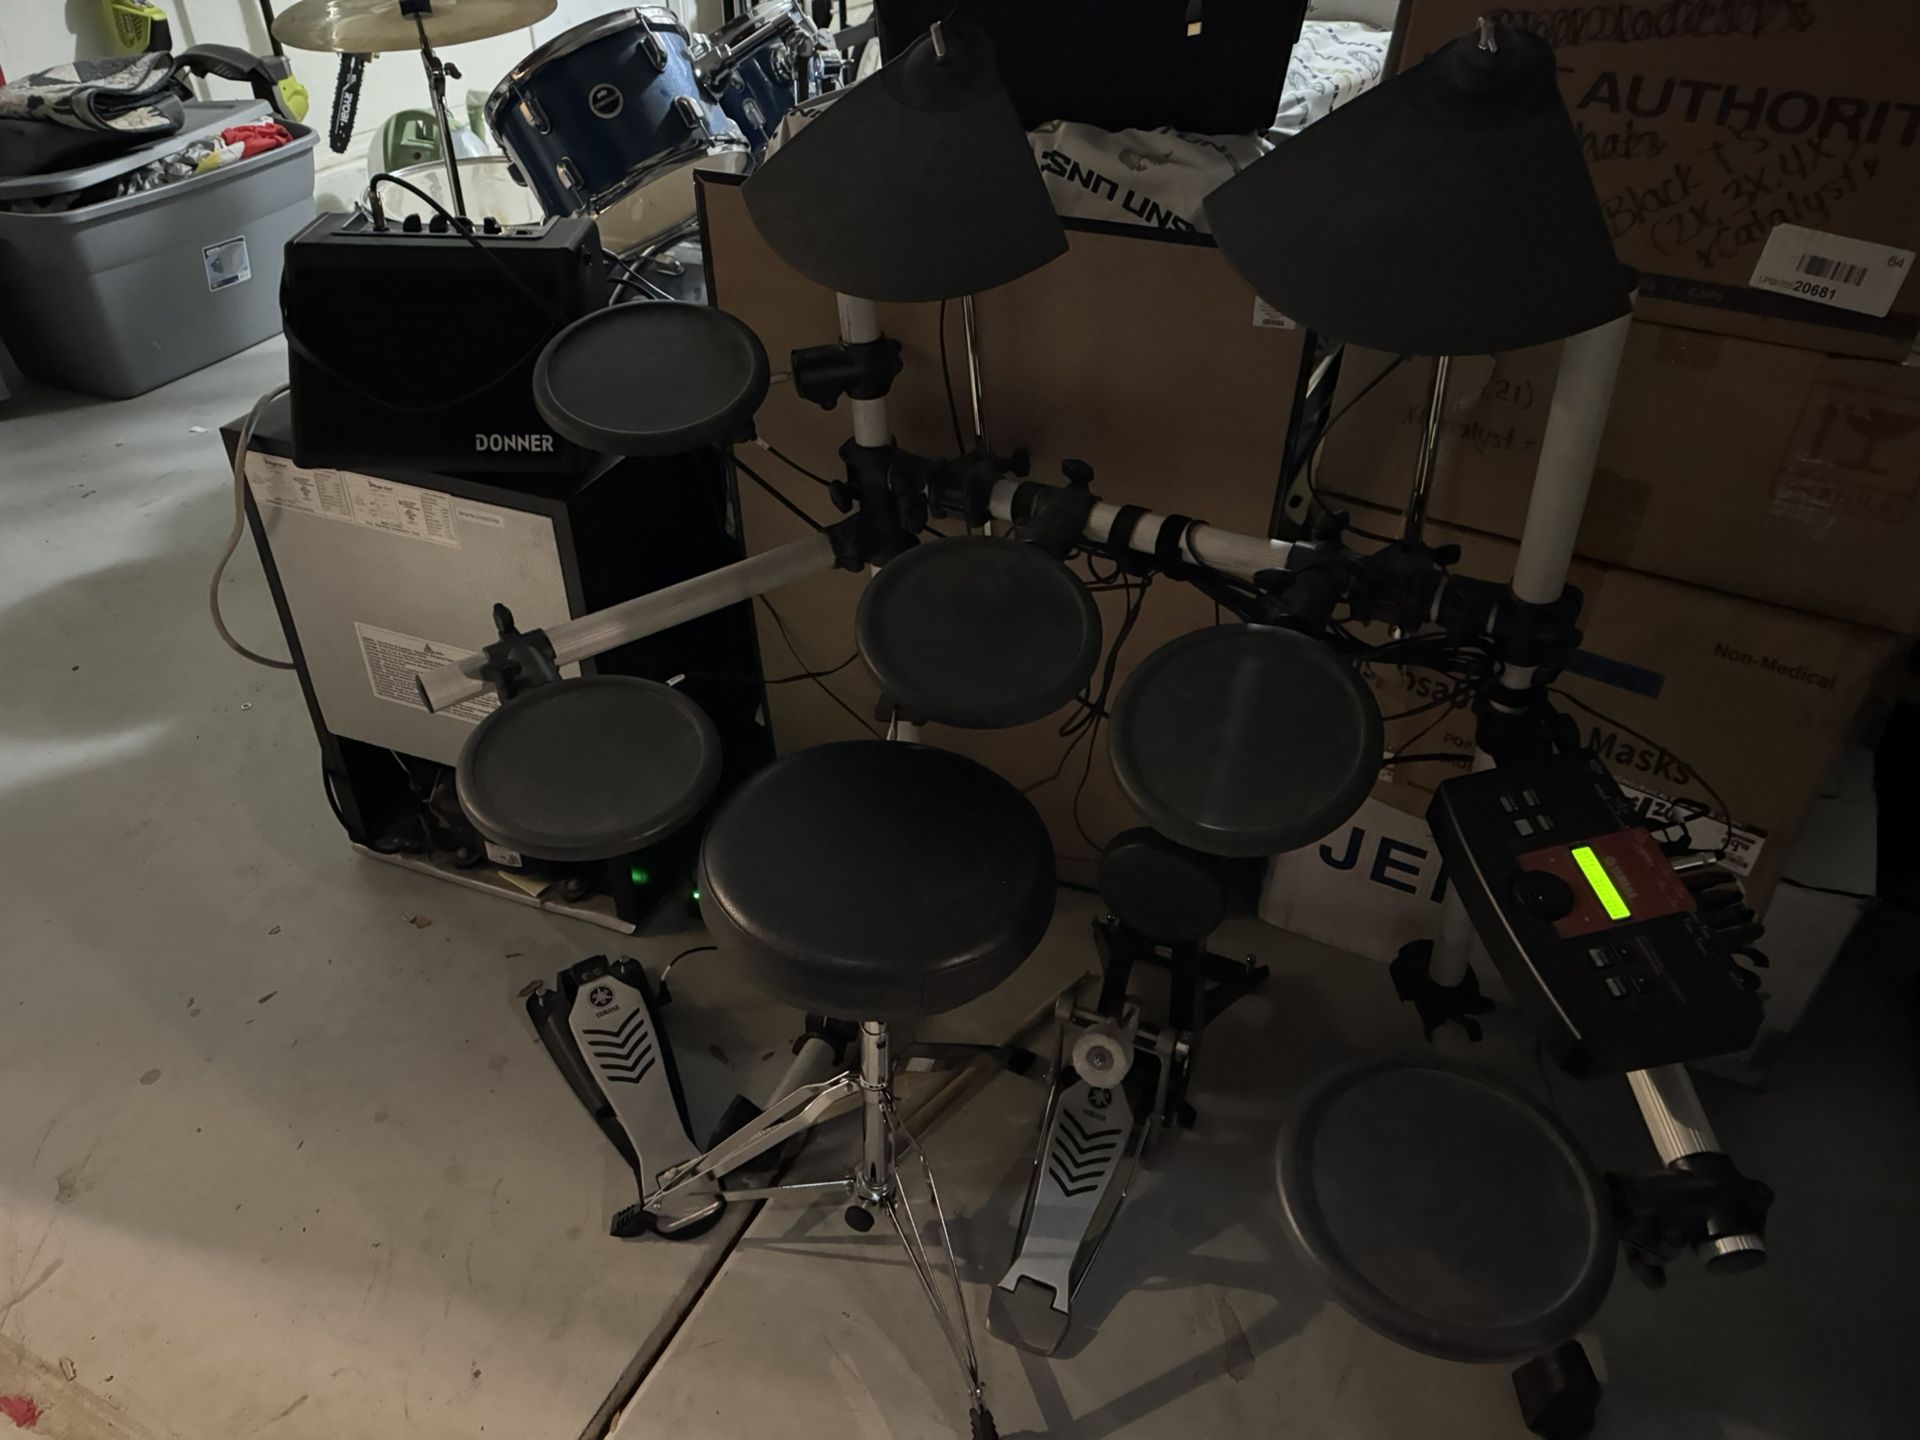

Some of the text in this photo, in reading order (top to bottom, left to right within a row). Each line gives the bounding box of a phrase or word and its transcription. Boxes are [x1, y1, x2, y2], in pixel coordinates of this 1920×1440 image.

[1576, 71, 1920, 148] AUTHORIT
[1602, 163, 1702, 239] Black
[475, 433, 555, 452] DONNER
[1713, 642, 1838, 691] Non-Medical
[1588, 726, 1691, 785] Masks
